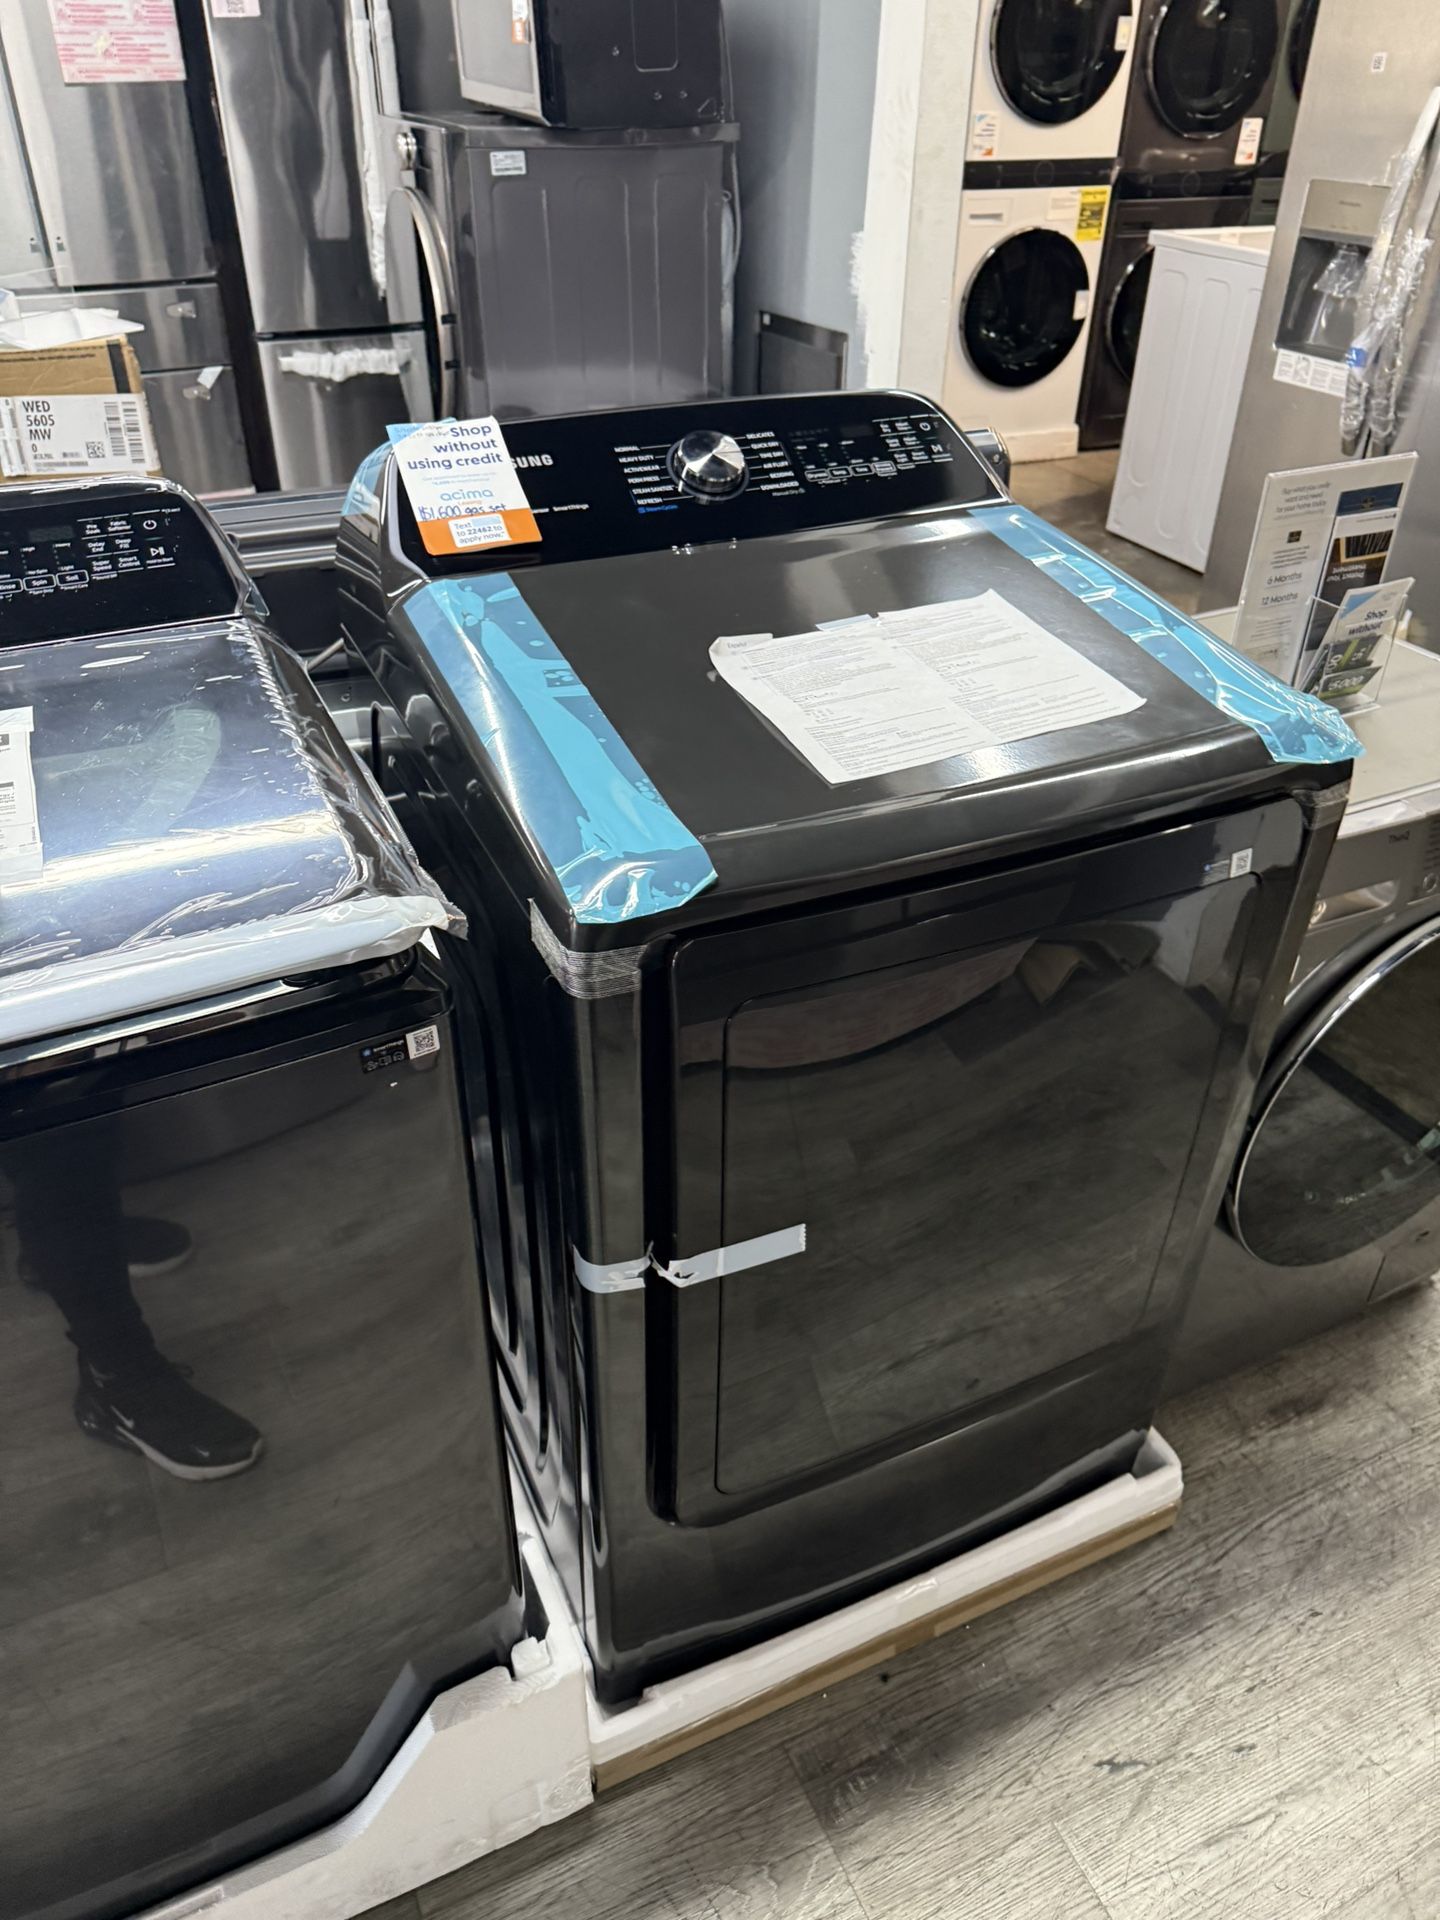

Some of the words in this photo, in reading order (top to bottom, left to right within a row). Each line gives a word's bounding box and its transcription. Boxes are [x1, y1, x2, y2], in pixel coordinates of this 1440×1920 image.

[22, 400, 51, 413] WED
[26, 414, 55, 427] 5605
[29, 428, 52, 441] MW
[450, 425, 492, 437] Shop
[746, 431, 775, 439] DELICATES
[433, 439, 498, 453] without
[613, 445, 640, 453] NORMAL
[407, 458, 453, 470] using
[455, 452, 503, 467] credit
[623, 465, 660, 473] ACTIVEWEAR
[769, 471, 795, 479] BEDDING
[760, 481, 800, 491] DOWNLOADED
[440, 489, 494, 501] acima
[636, 497, 663, 505] REFRESH
[464, 506, 485, 516] gas
[489, 503, 506, 513] set
[466, 527, 492, 535] 22462
[459, 535, 482, 544] apply
[87, 541, 106, 549] Delay
[92, 559, 110, 567] Super
[93, 564, 112, 572] Speed
[118, 560, 141, 569] Control
[1274, 572, 1302, 583] Months
[32, 579, 48, 587] Spin
[1261, 596, 1270, 605] 12
[1270, 592, 1298, 603] Months
[1364, 609, 1388, 621] Shop
[1348, 621, 1383, 635] without
